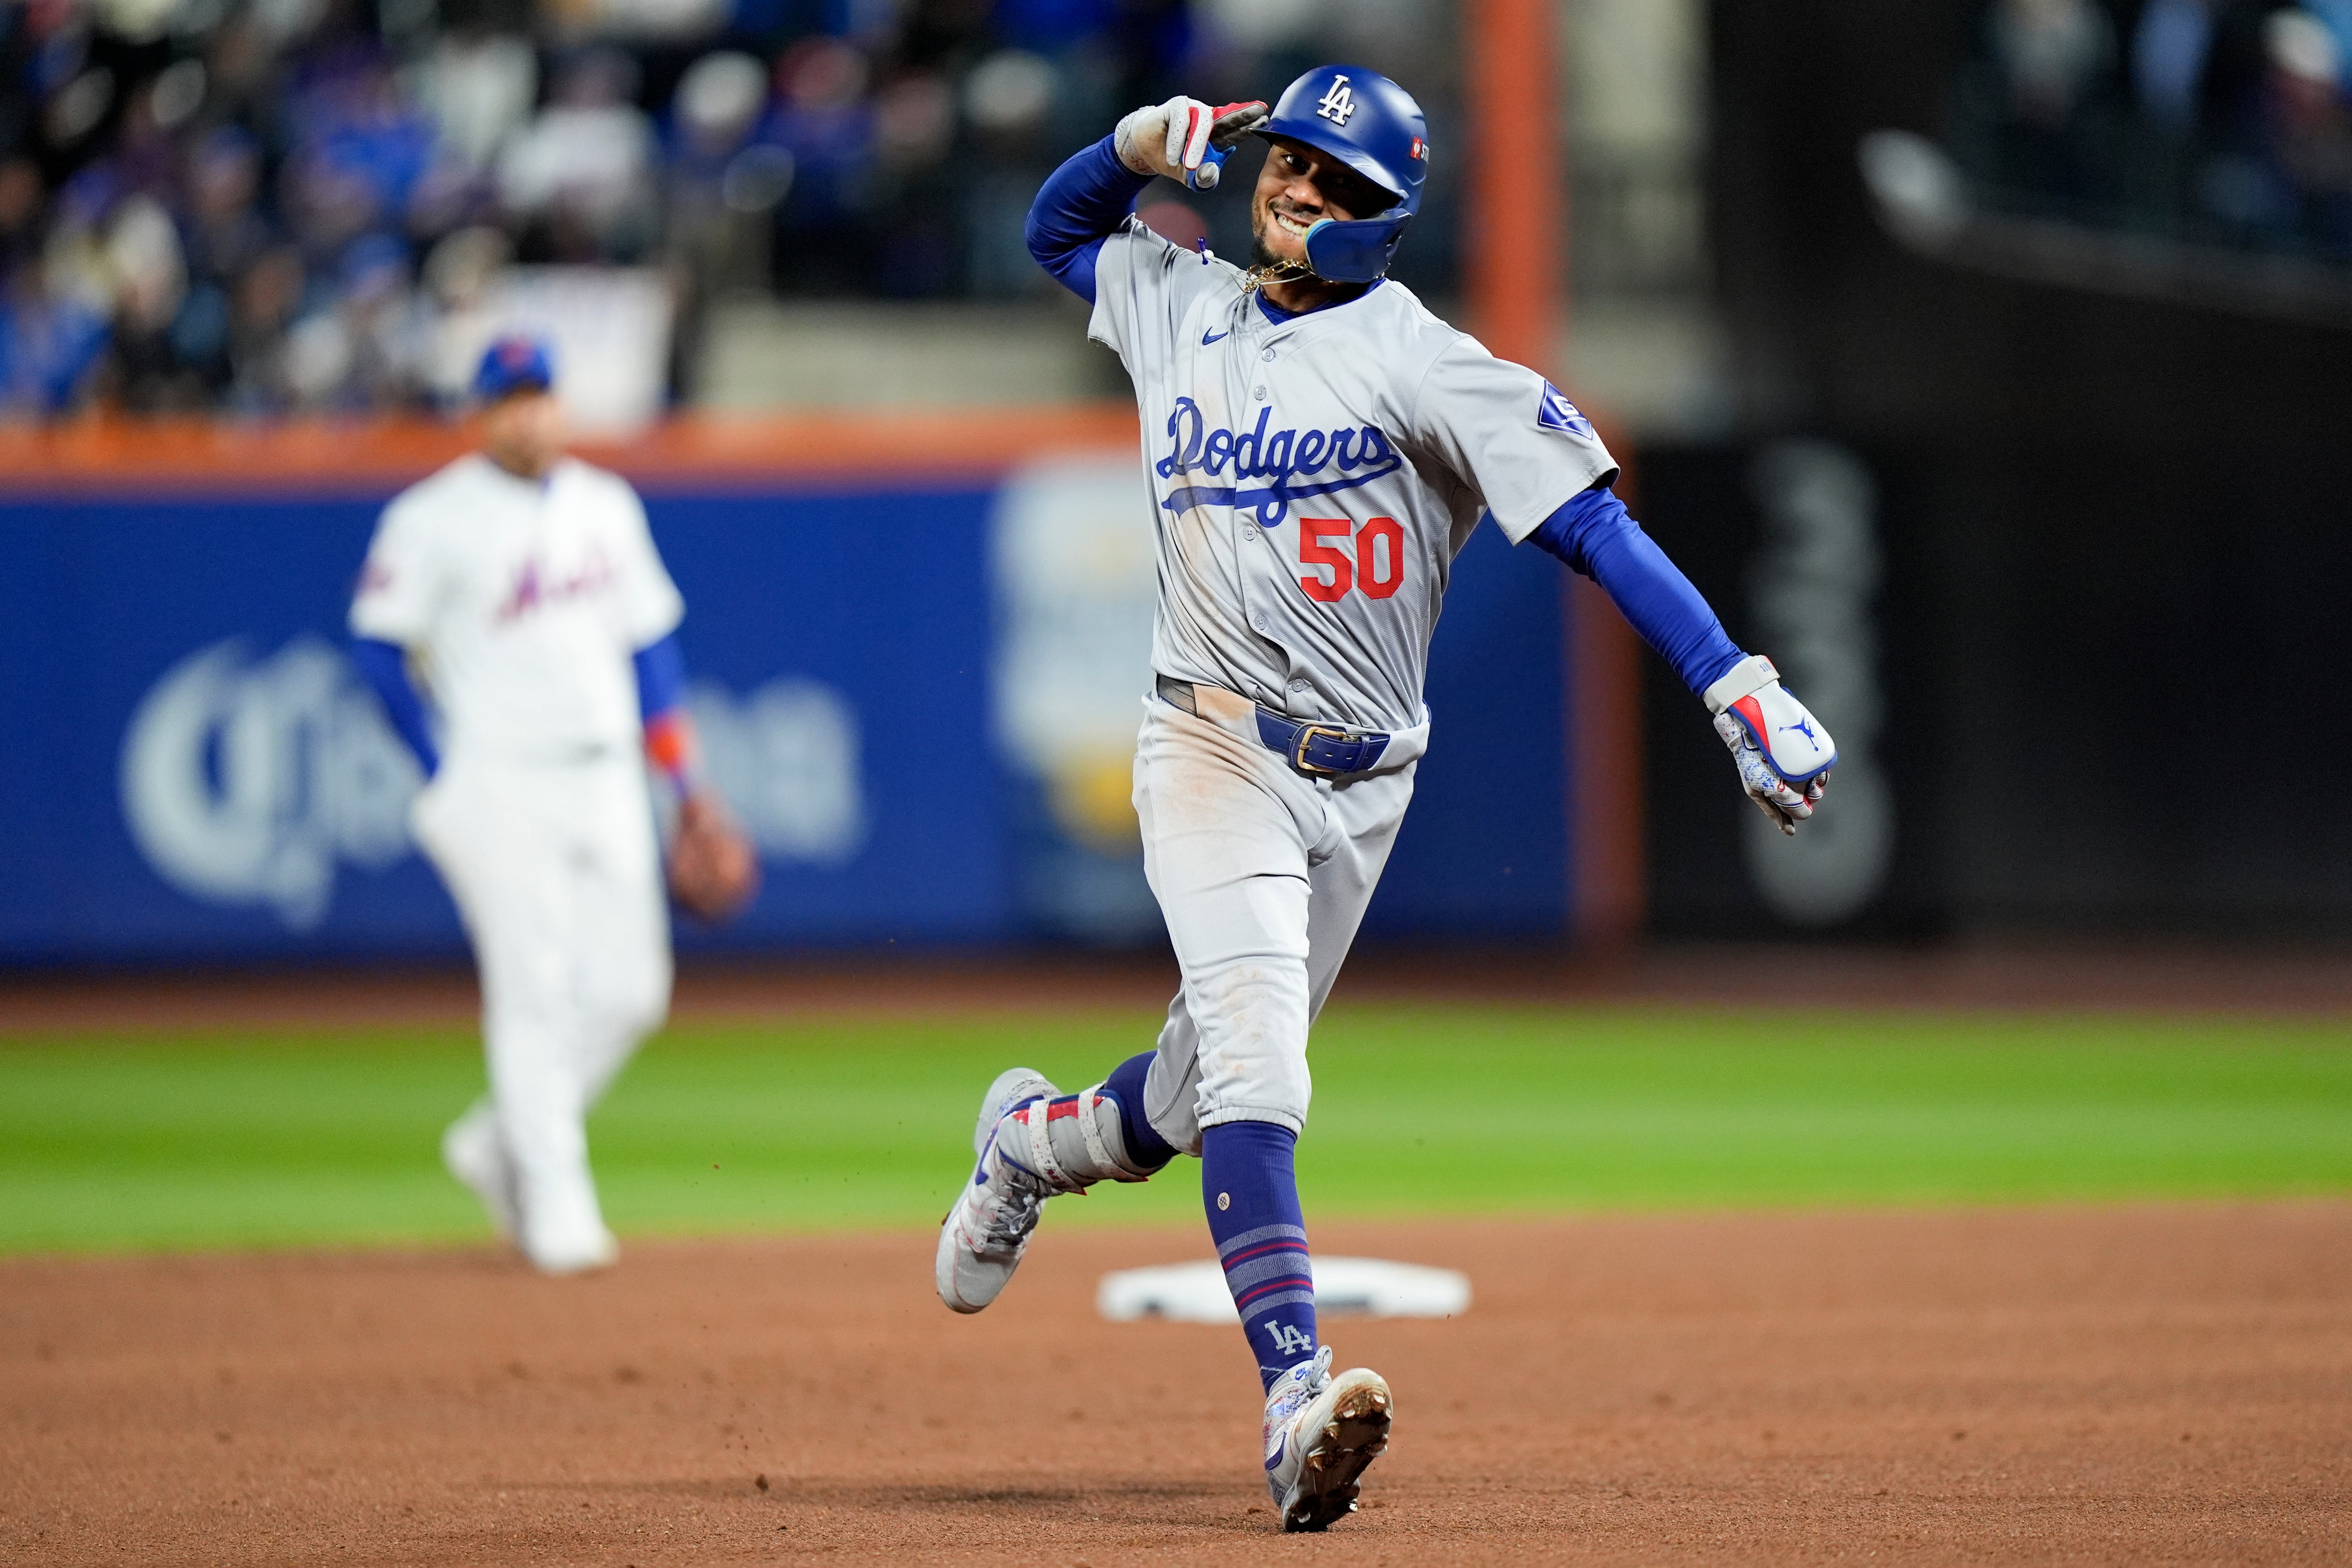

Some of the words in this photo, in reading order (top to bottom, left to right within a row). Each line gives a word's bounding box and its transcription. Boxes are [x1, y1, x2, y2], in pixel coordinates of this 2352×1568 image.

[1317, 74, 1355, 125] LA
[1157, 397, 1401, 528] Dodgers
[1300, 517, 1404, 602] 50
[1264, 1319, 1312, 1356] LA
